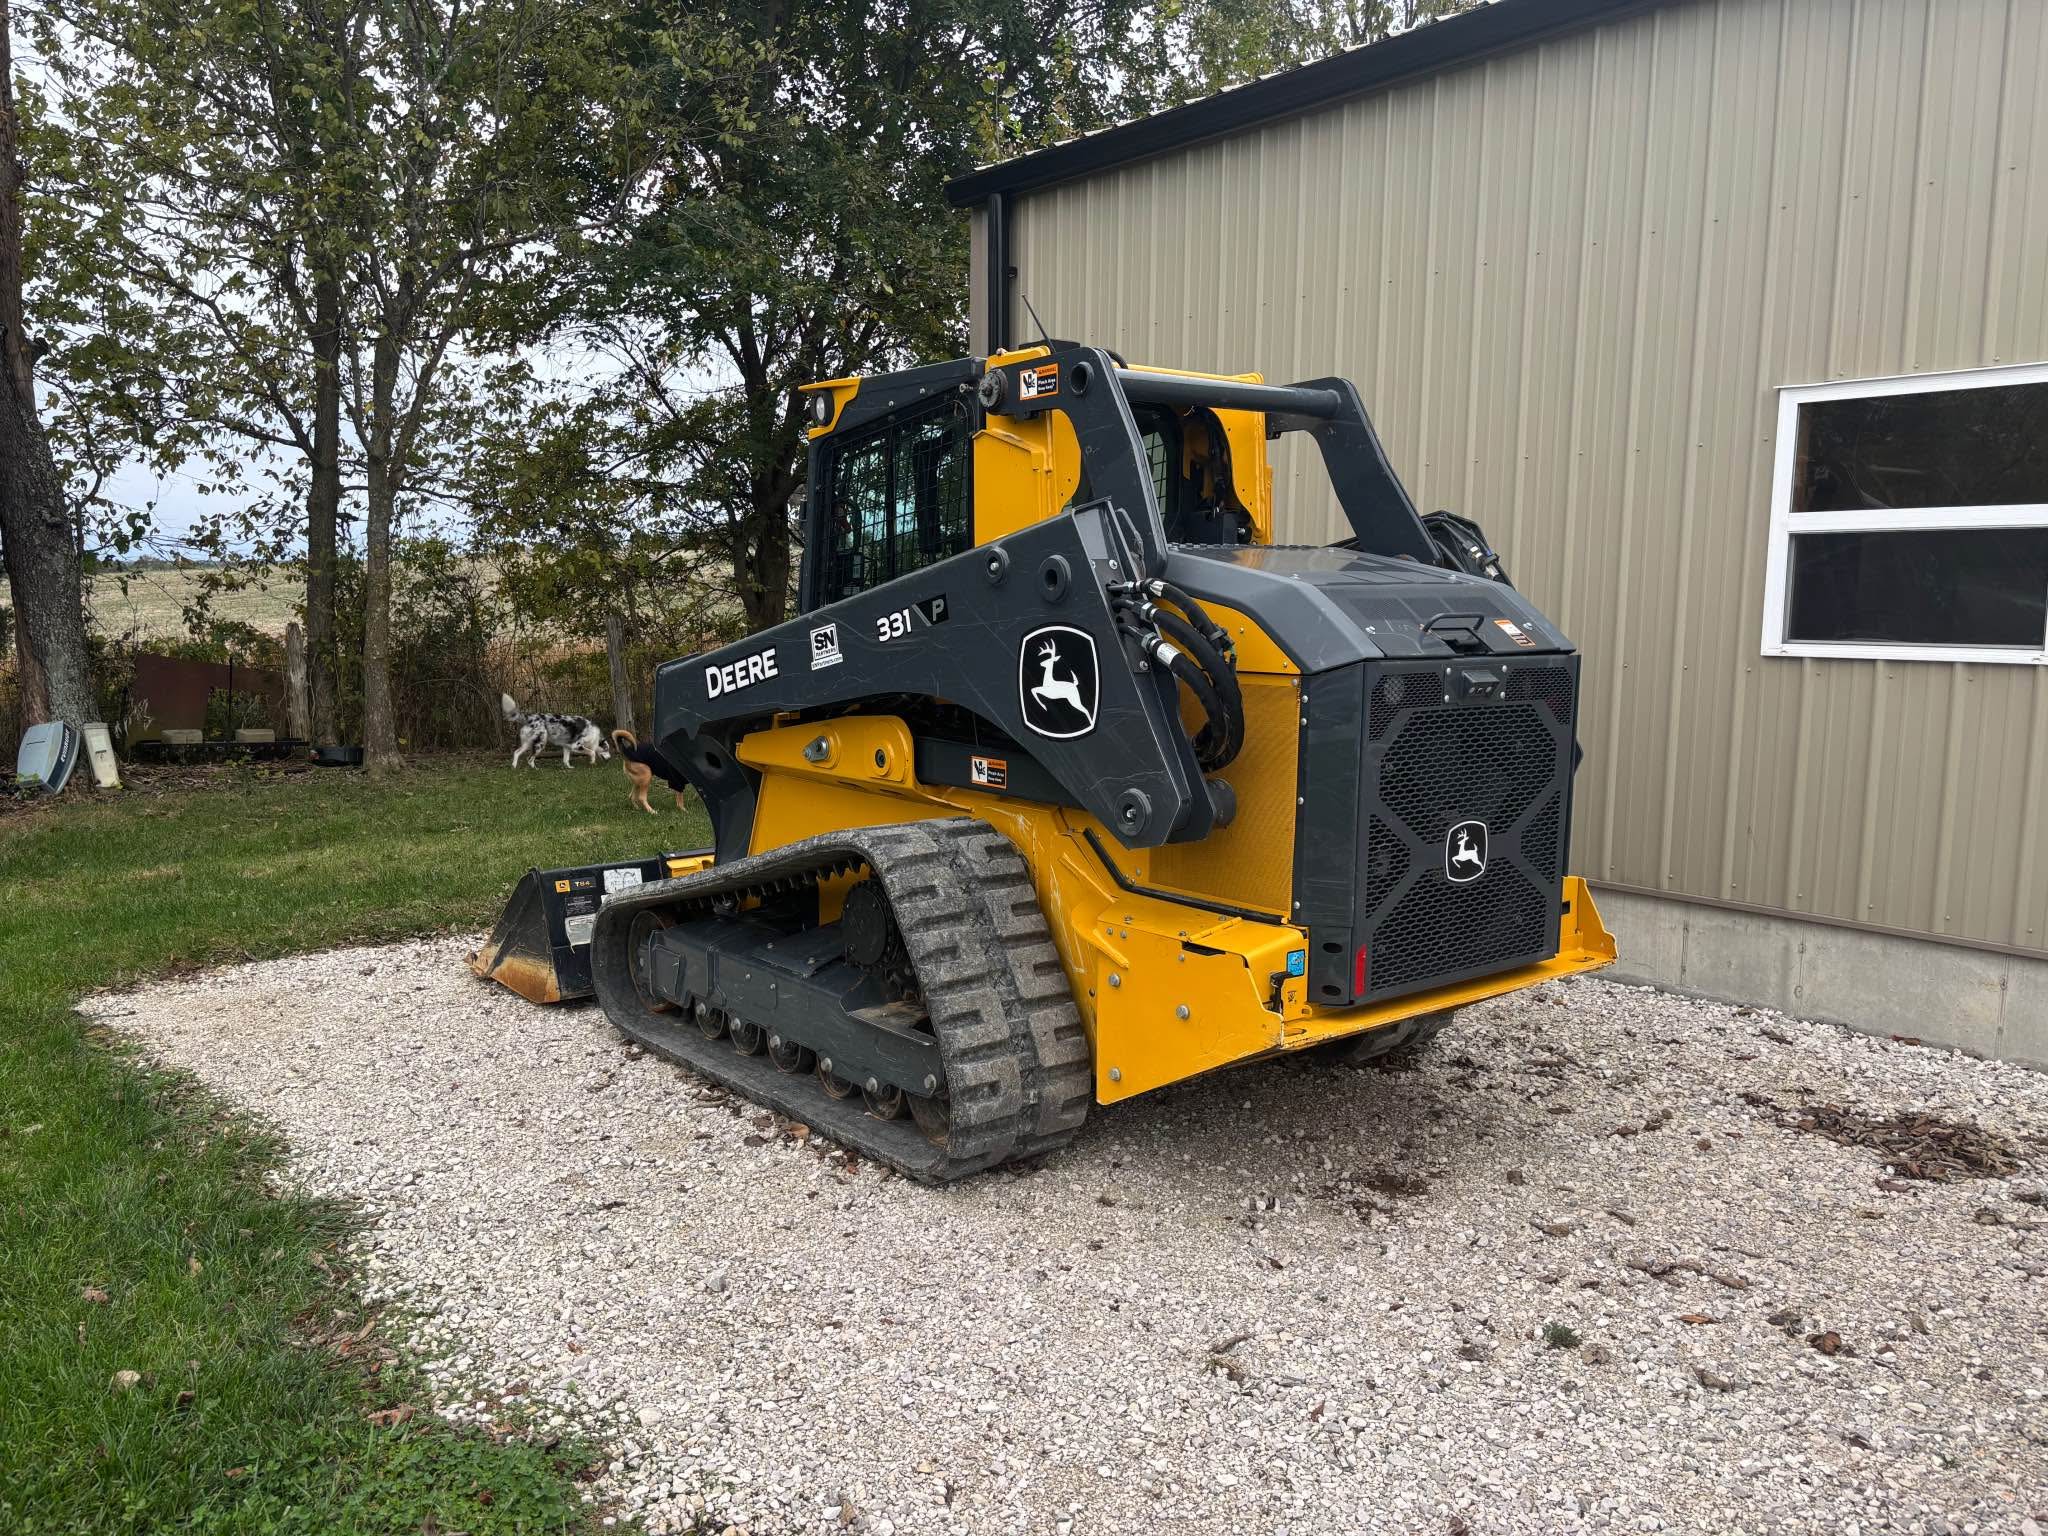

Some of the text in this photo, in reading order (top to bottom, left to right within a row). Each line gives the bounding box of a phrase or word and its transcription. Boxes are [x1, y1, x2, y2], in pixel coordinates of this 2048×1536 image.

[814, 629, 836, 651] SN
[876, 598, 944, 642] 331 P
[705, 647, 779, 699] DEERE
